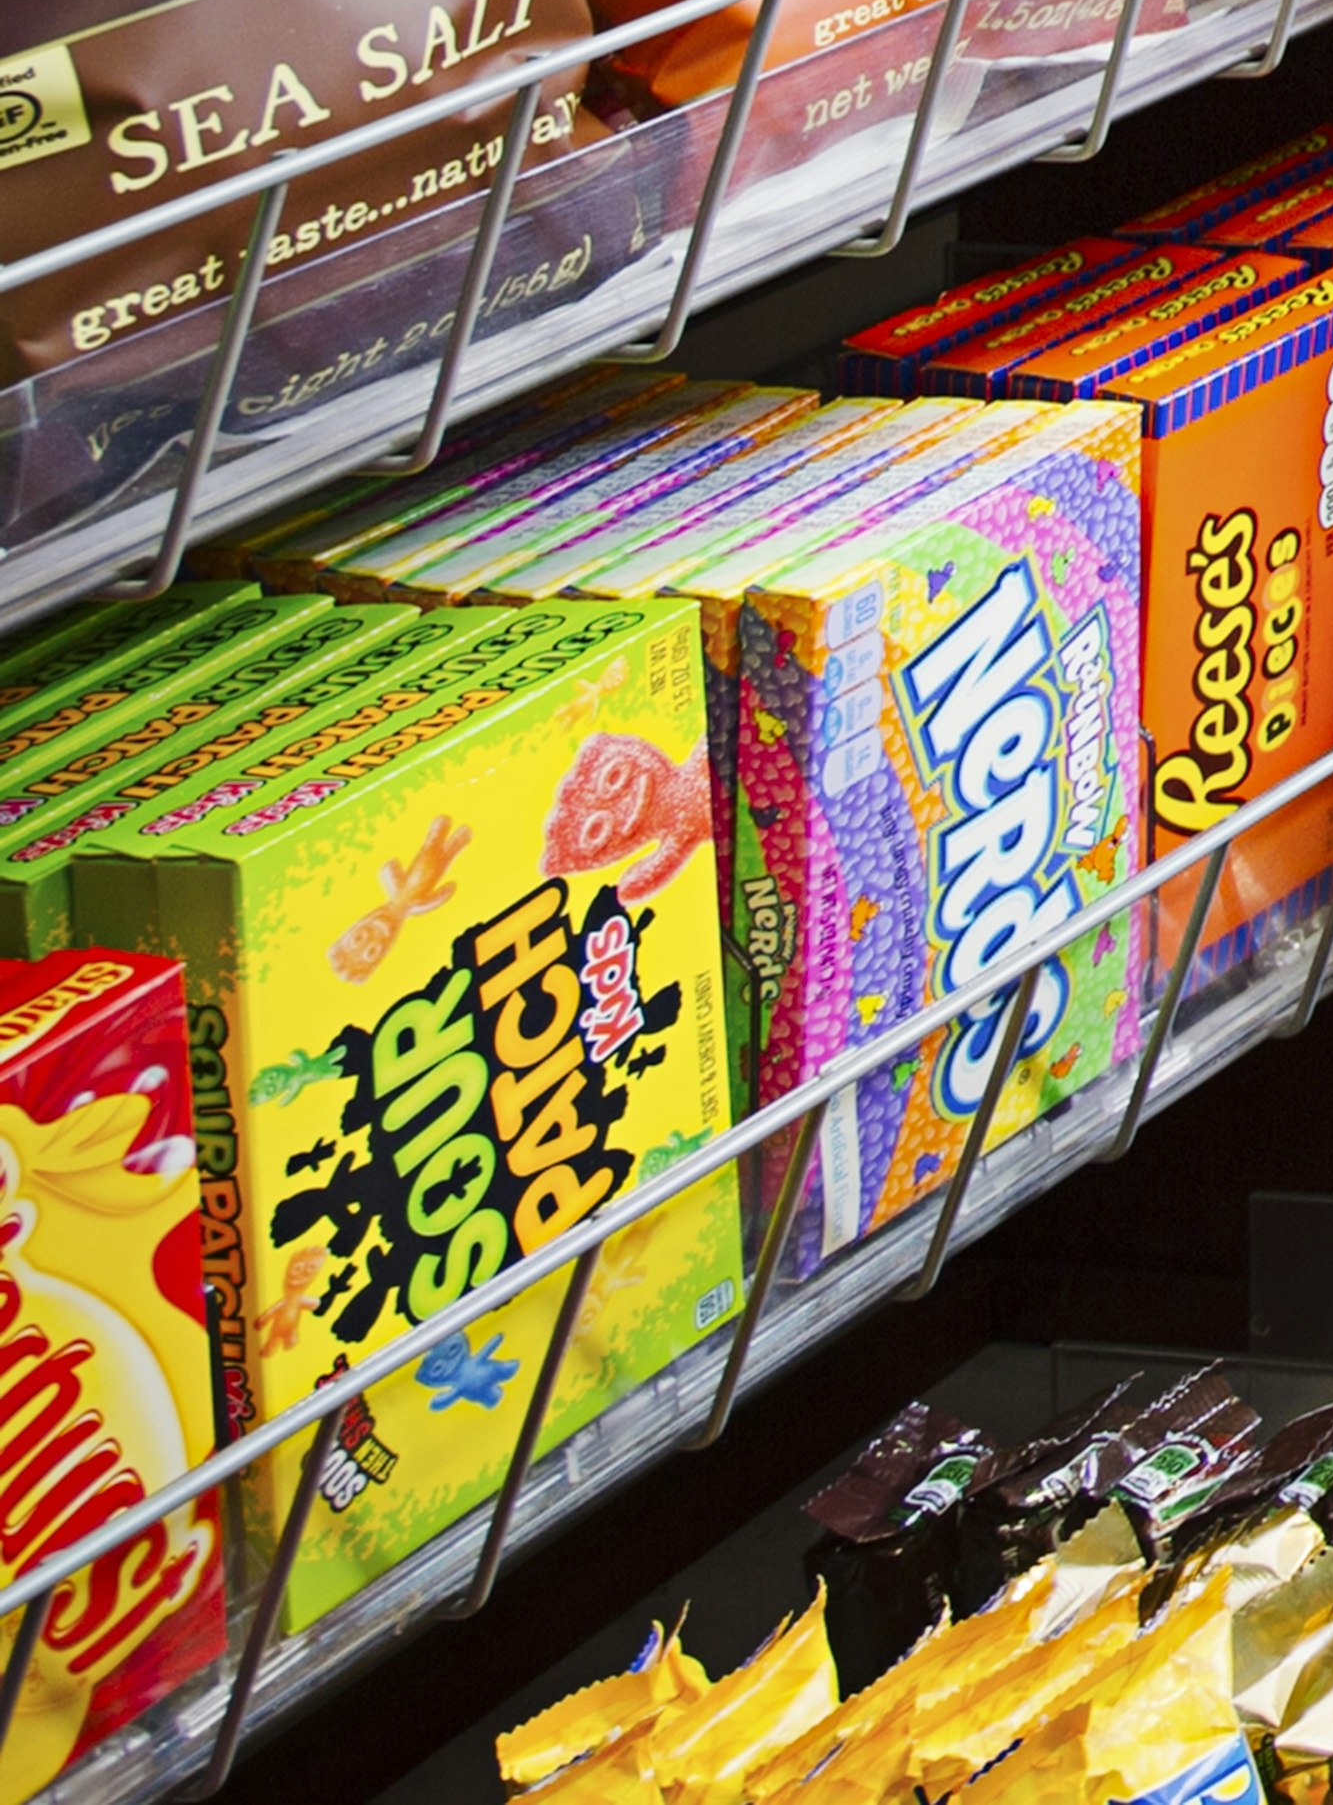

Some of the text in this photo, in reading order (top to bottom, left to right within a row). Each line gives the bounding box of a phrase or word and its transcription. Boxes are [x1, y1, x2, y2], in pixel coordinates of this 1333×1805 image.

[107, 62, 331, 196] SEA
[802, 75, 873, 135] net
[70, 255, 225, 354] great
[855, 592, 877, 626] 60
[242, 613, 566, 779] SOUR PATCH
[283, 622, 455, 705] SOUR
[323, 611, 646, 779] SOUR PATCH
[1155, 506, 1254, 834] Reese's
[116, 702, 312, 800] PATCH
[899, 891, 919, 959] crunchy
[694, 968, 714, 1022] CANDY
[896, 963, 919, 1019] candy
[189, 1003, 240, 1179] SOUR
[477, 878, 612, 1258] PATCH
[372, 967, 510, 1325] SOUR
[319, 1443, 369, 1512] SOU
